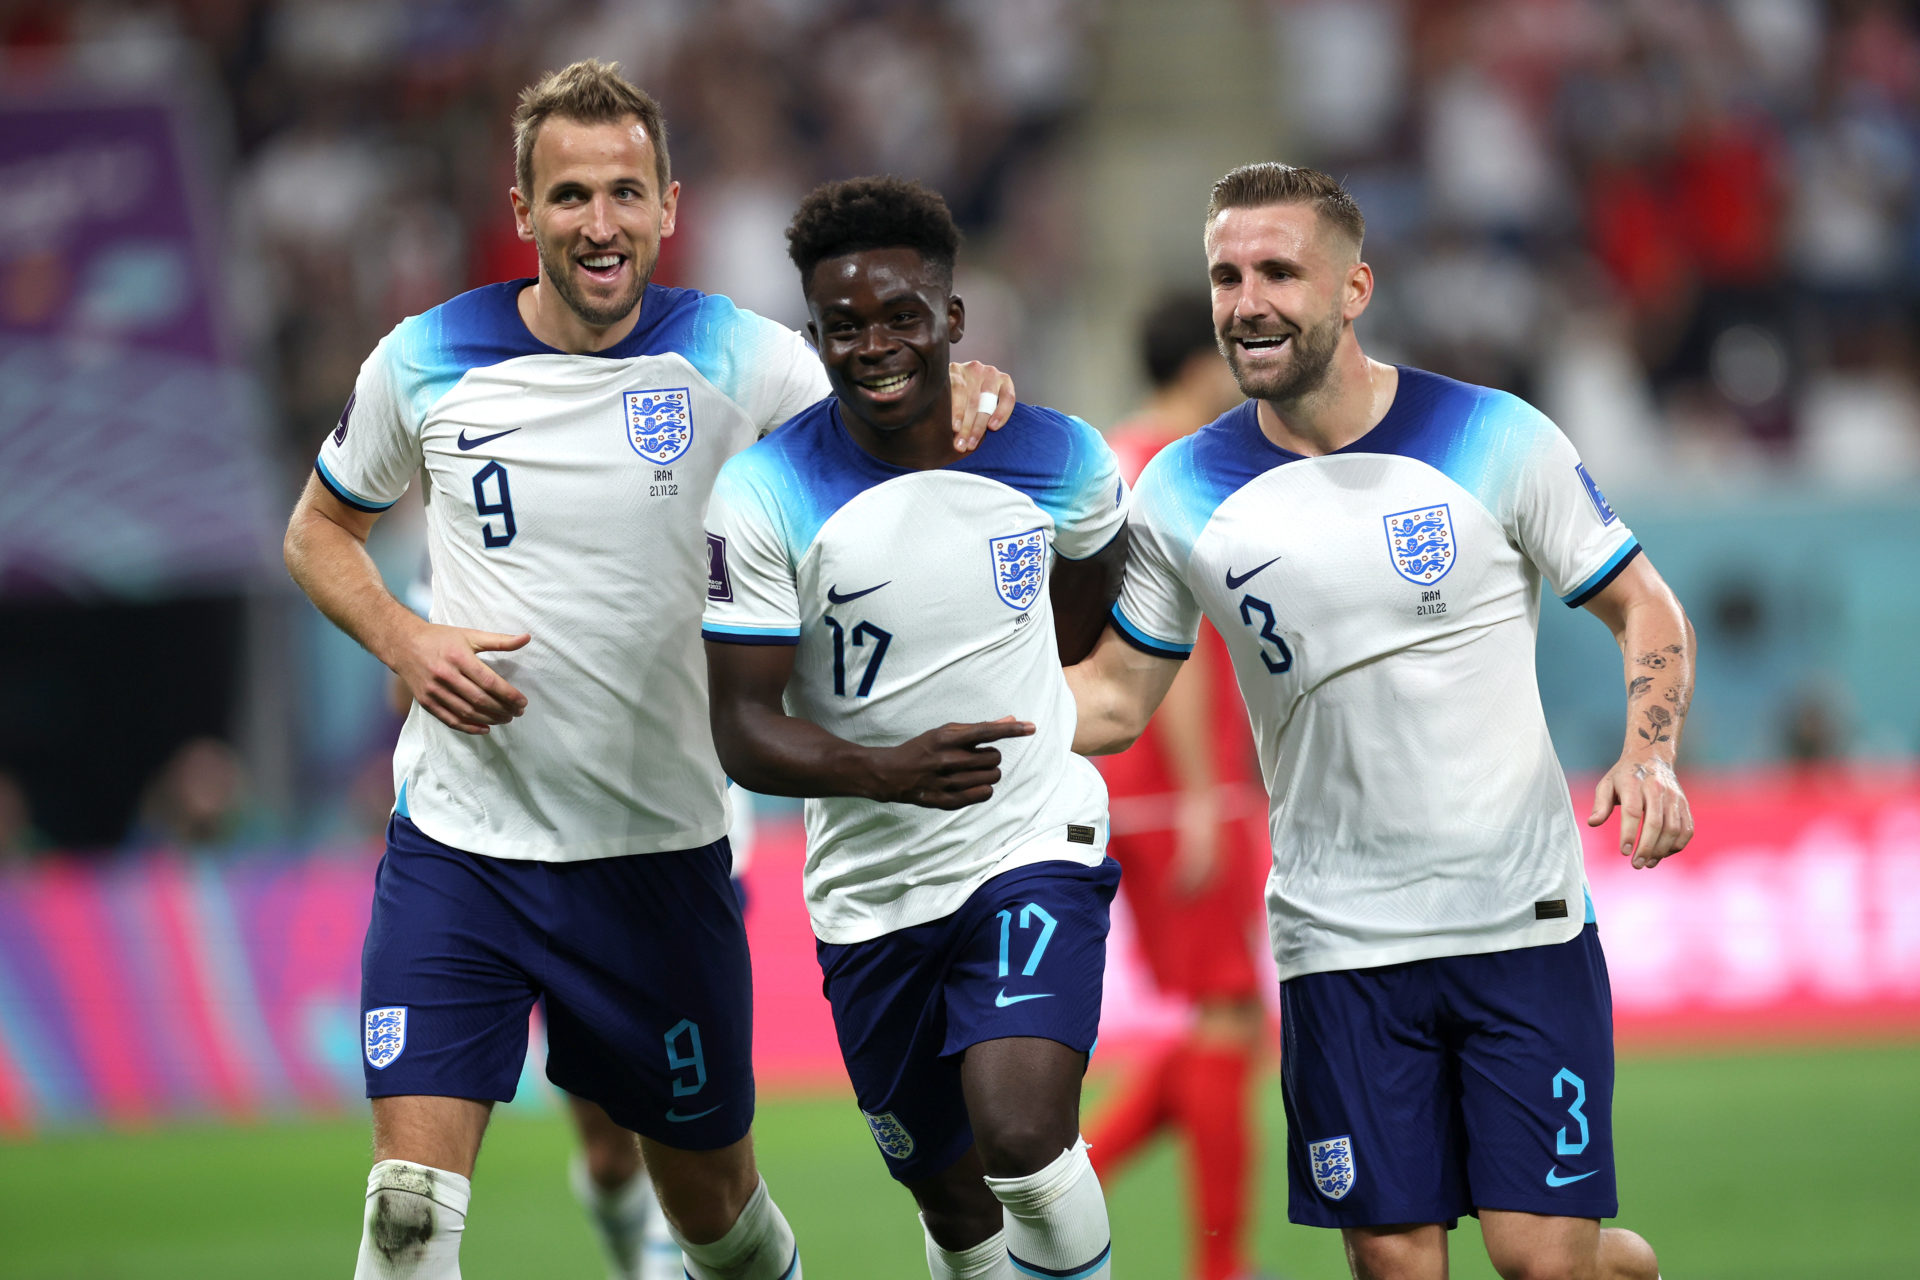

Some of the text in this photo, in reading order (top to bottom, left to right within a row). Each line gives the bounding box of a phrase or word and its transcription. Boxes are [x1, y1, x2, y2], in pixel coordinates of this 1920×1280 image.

[472, 459, 517, 549] 9
[649, 484, 678, 497] 21.11.22
[1239, 593, 1293, 675] 3
[1416, 602, 1447, 616] 21.11.22
[823, 614, 893, 698] 17
[996, 902, 1058, 978] 17
[663, 1018, 707, 1098] 9
[1552, 1067, 1590, 1155] 3
